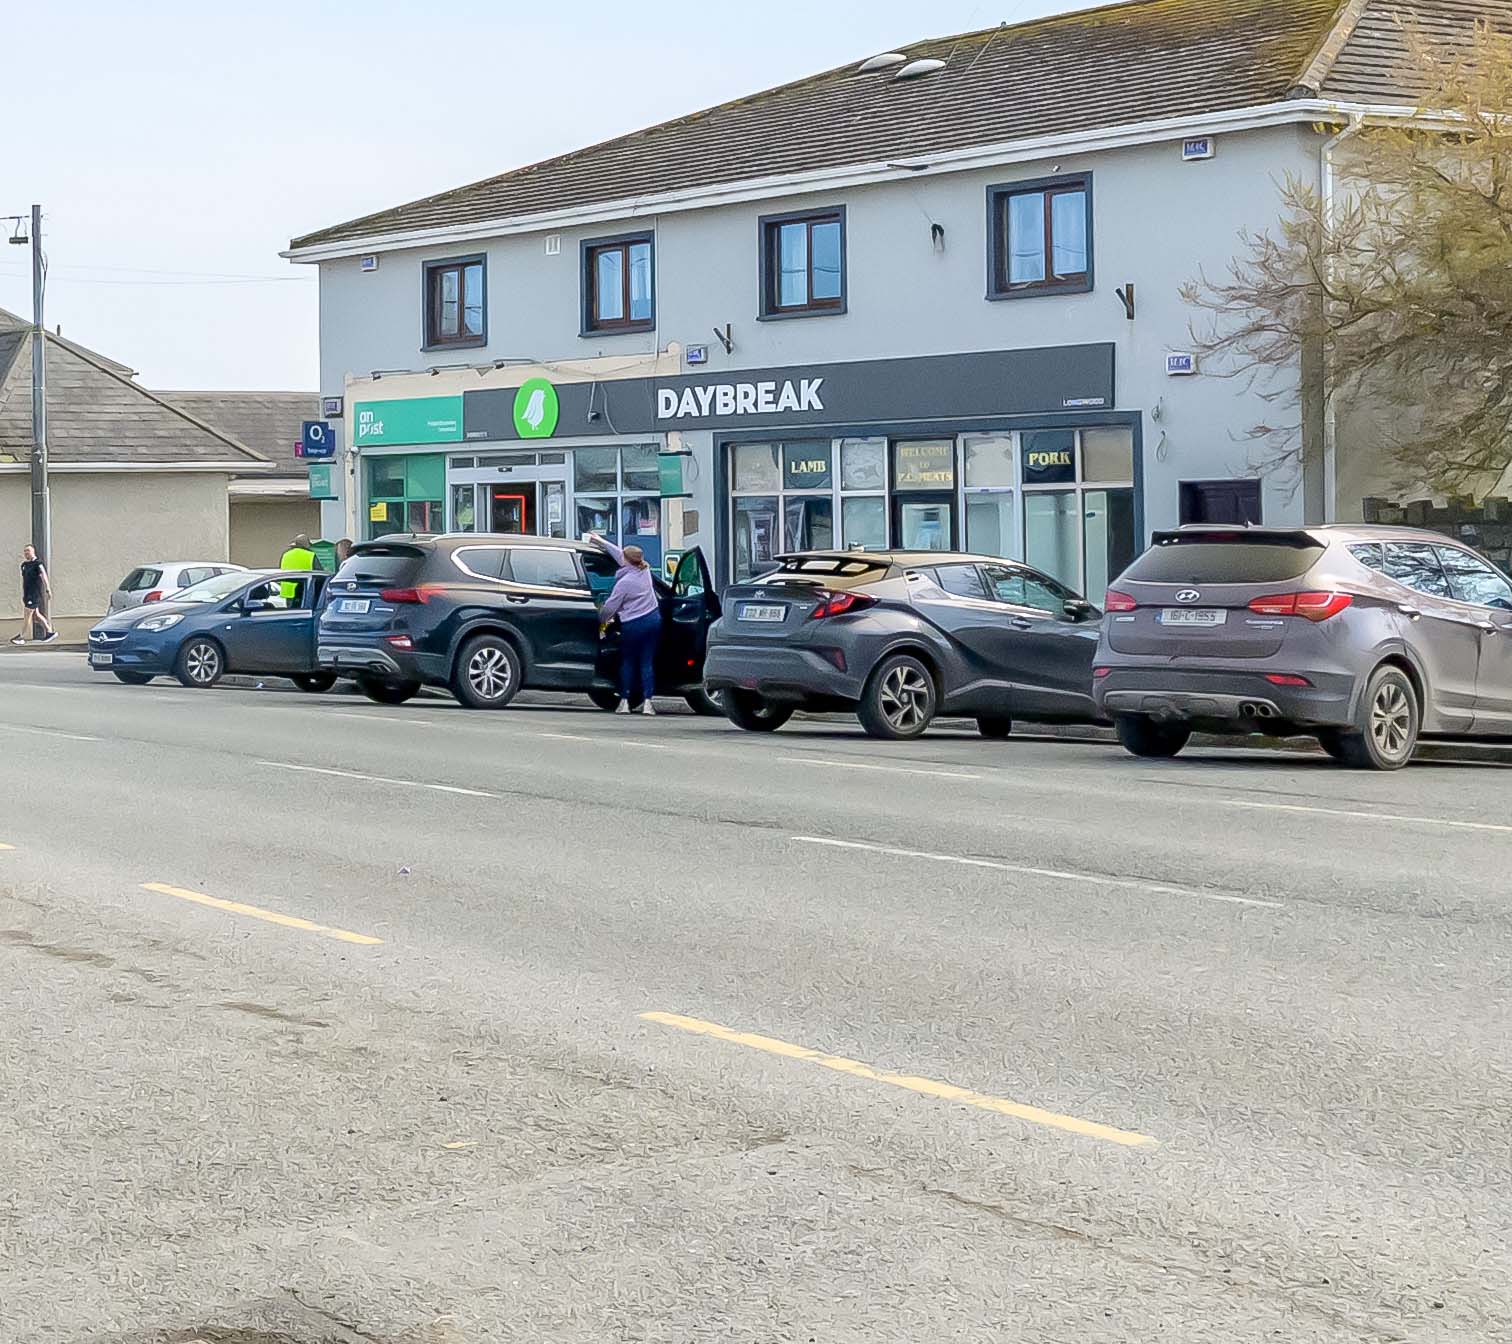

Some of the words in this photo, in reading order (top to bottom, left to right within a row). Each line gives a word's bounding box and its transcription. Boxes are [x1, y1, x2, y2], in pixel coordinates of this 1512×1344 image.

[657, 378, 824, 419] DAYBREAK
[359, 411, 374, 423] an
[1029, 451, 1072, 466] PORK
[791, 459, 826, 474] LAMB
